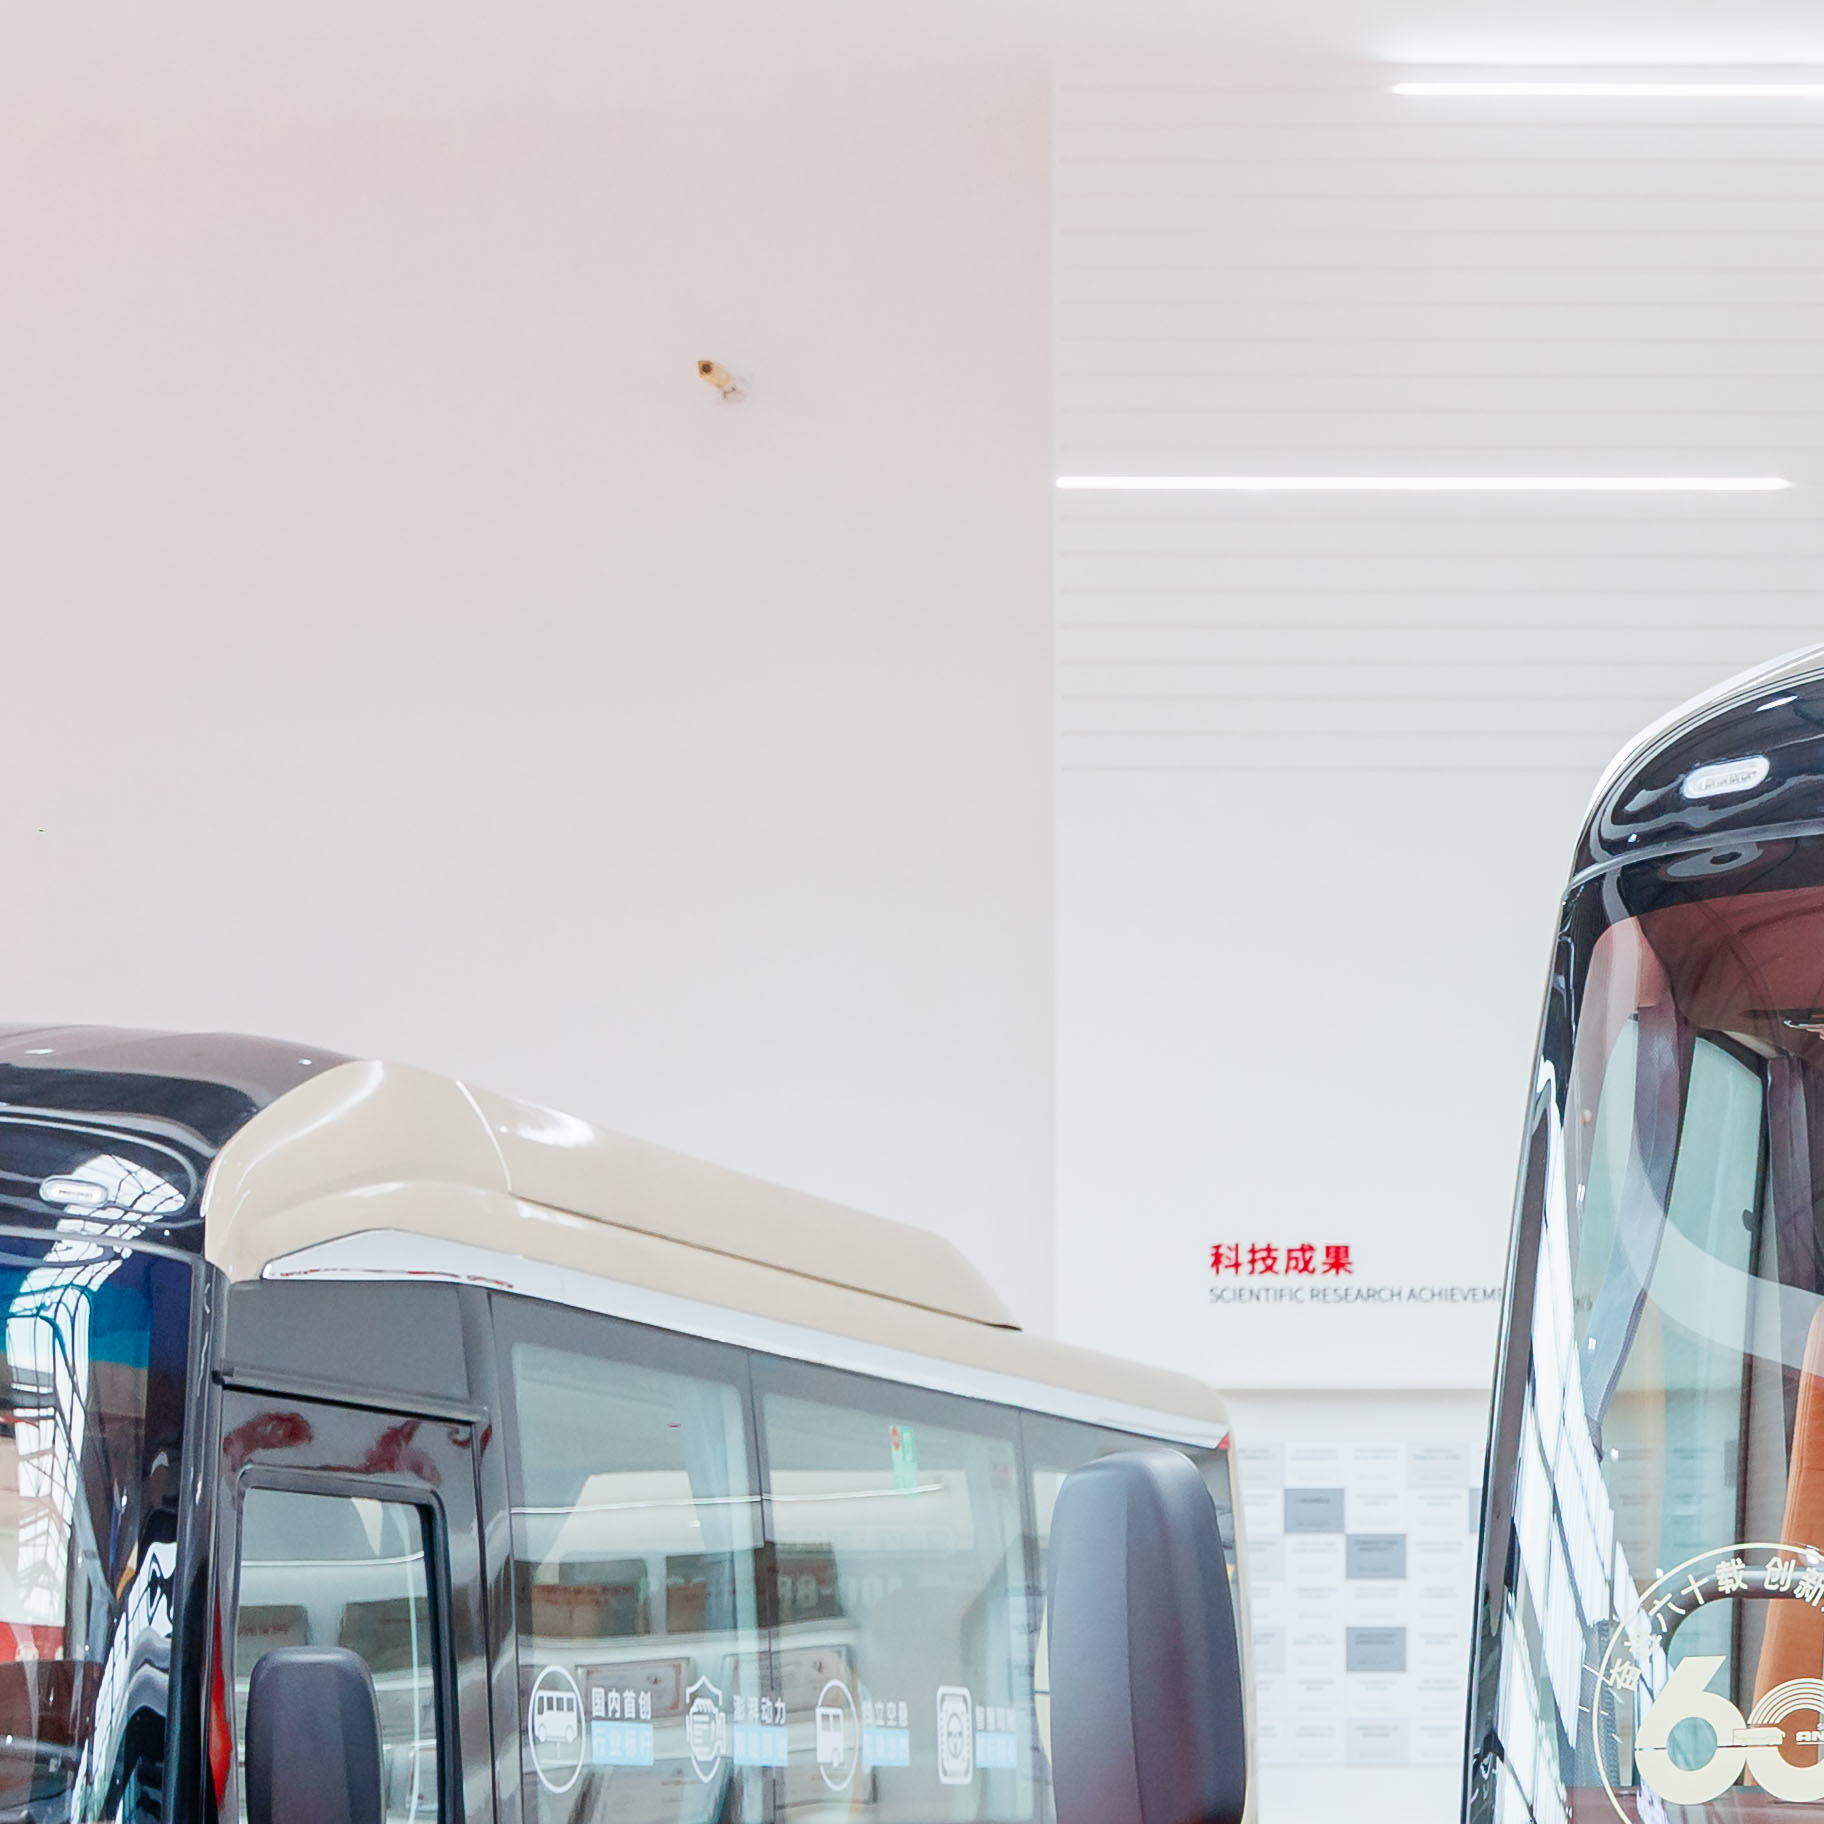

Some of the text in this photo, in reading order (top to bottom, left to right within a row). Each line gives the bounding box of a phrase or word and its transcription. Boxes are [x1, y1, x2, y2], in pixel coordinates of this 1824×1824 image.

[1209, 1243, 1354, 1276] 科技成果
[1209, 1287, 1306, 1304] SCIENTIFIC
[1310, 1287, 1401, 1303] RESEARCH
